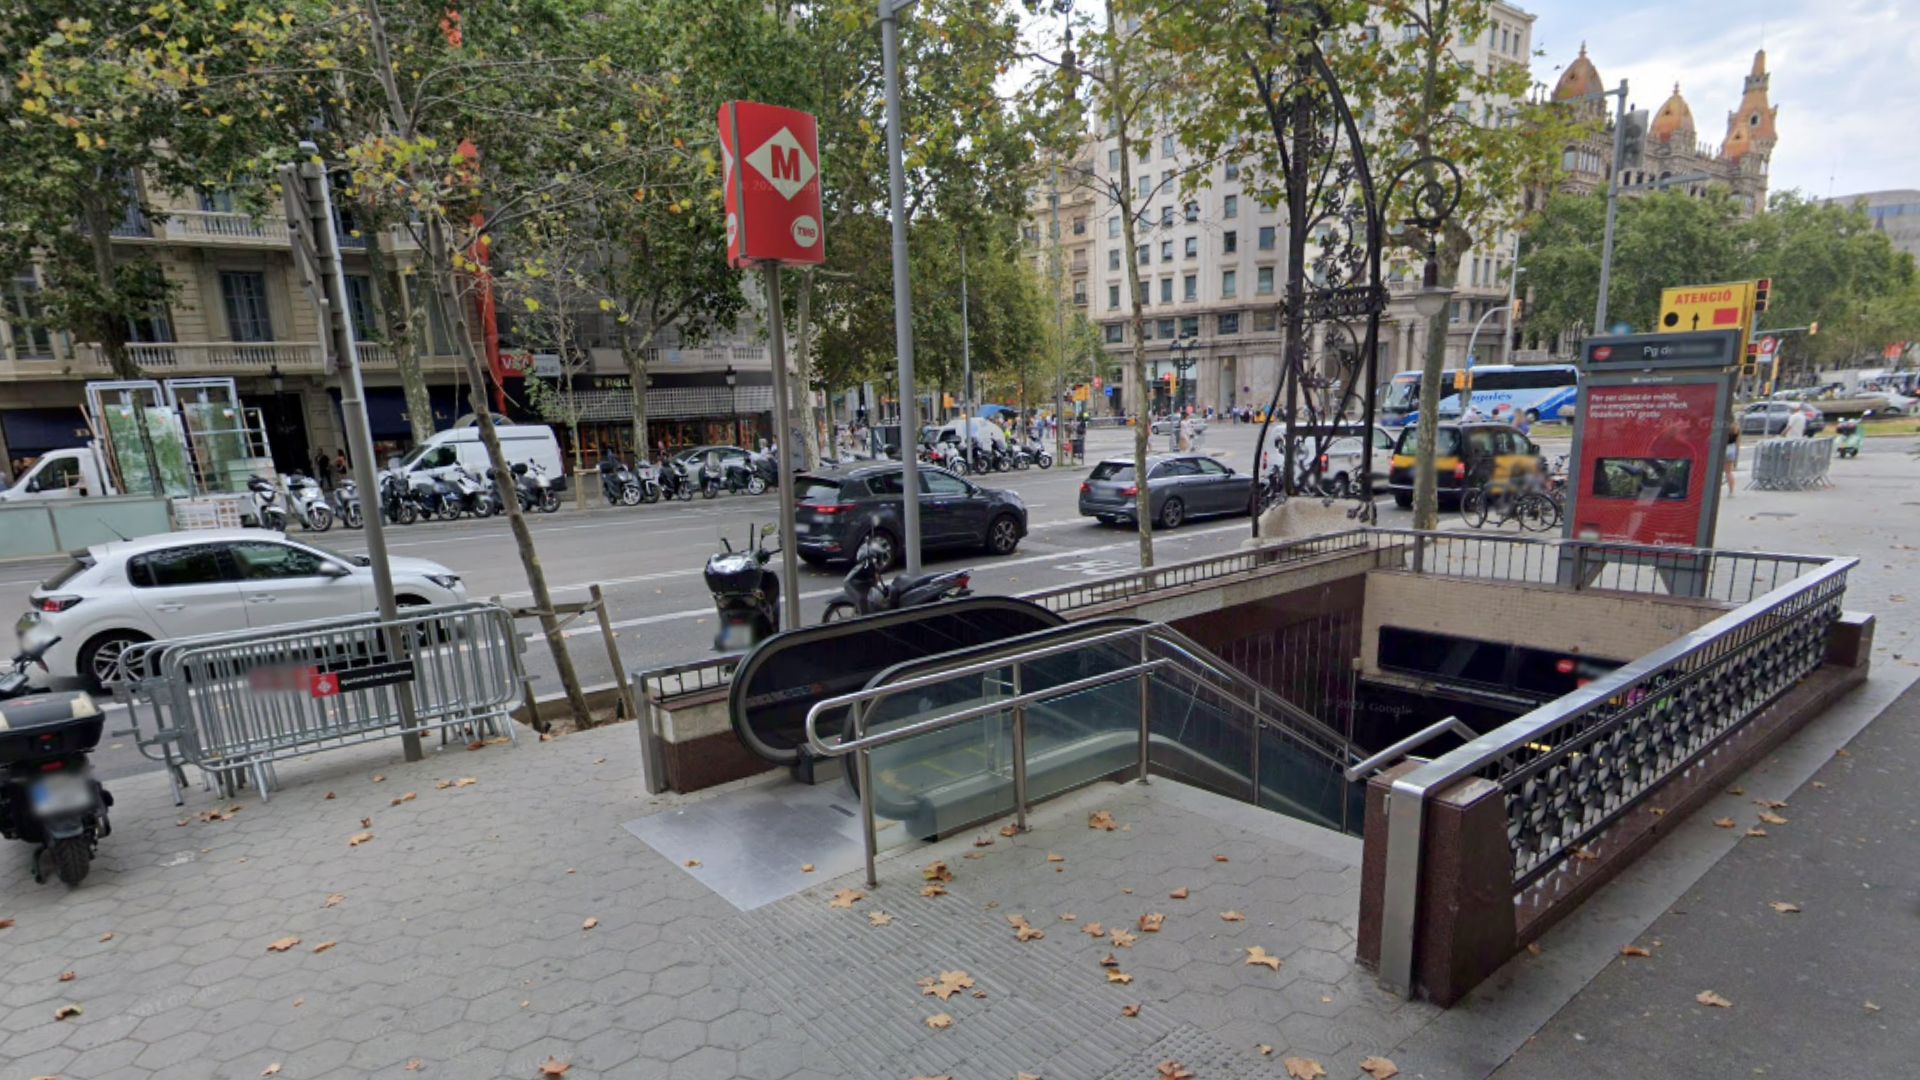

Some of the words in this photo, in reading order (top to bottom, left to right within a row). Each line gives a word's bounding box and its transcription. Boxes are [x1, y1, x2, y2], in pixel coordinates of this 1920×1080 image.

[772, 145, 801, 182] M
[798, 227, 815, 238] TMB
[1676, 290, 1732, 304] ATENCIÓ
[1668, 401, 1688, 409] Pack
